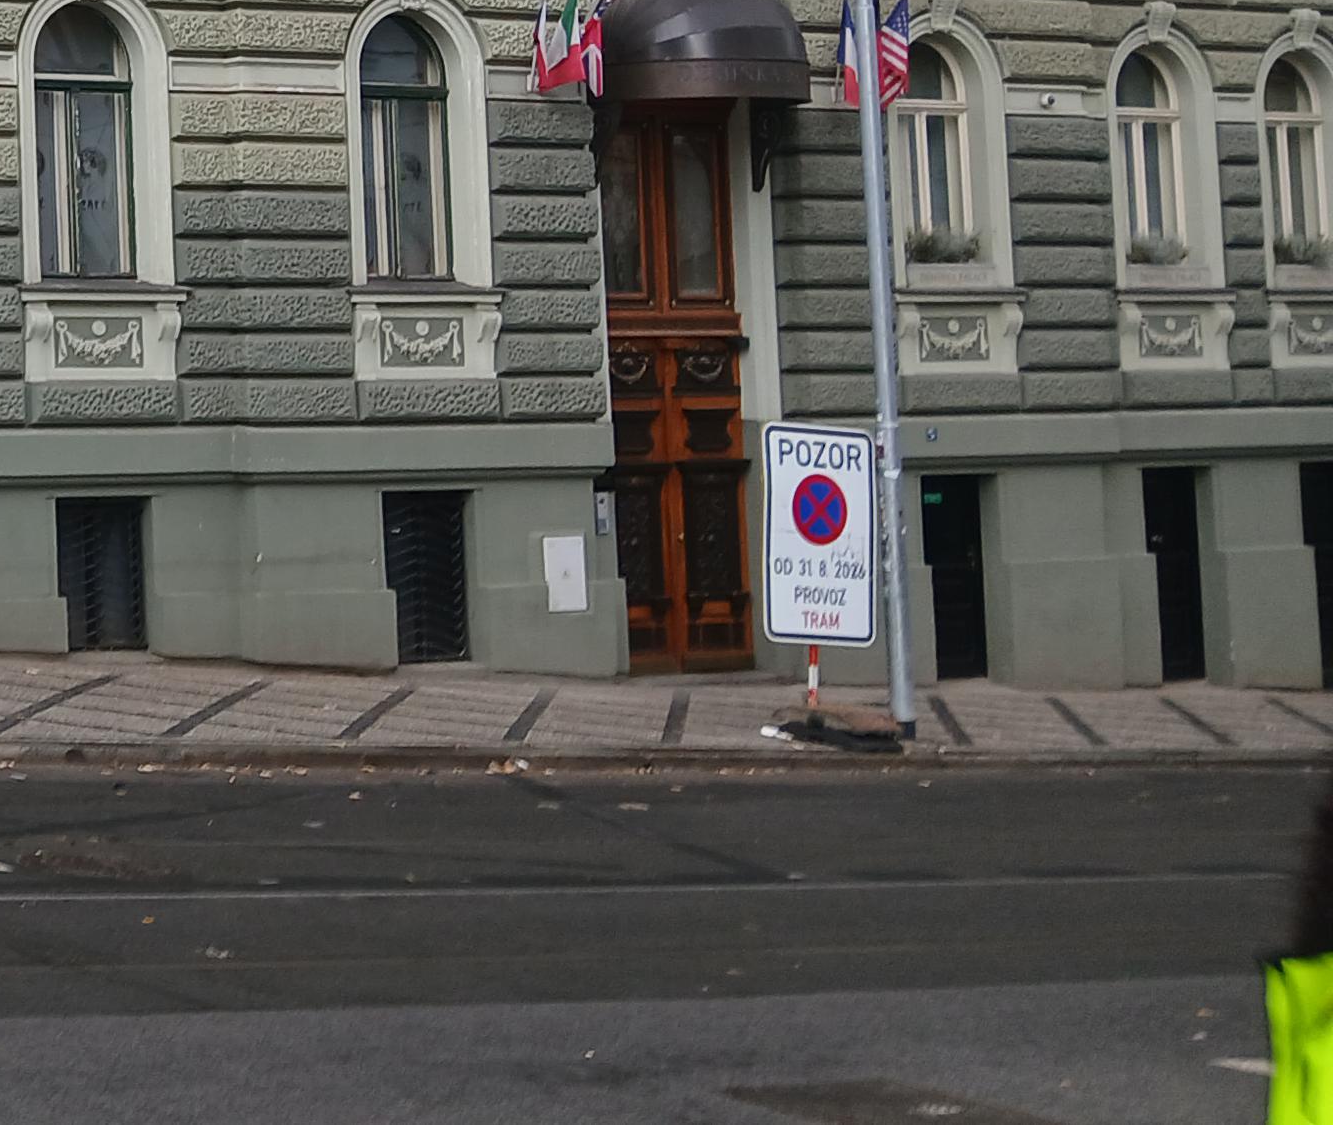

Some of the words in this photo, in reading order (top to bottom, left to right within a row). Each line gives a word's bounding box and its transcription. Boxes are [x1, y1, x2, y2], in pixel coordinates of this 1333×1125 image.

[778, 439, 862, 472] POZOR
[774, 557, 793, 575] OD
[794, 585, 847, 606] PROVOZ
[801, 611, 840, 630] TRAM
